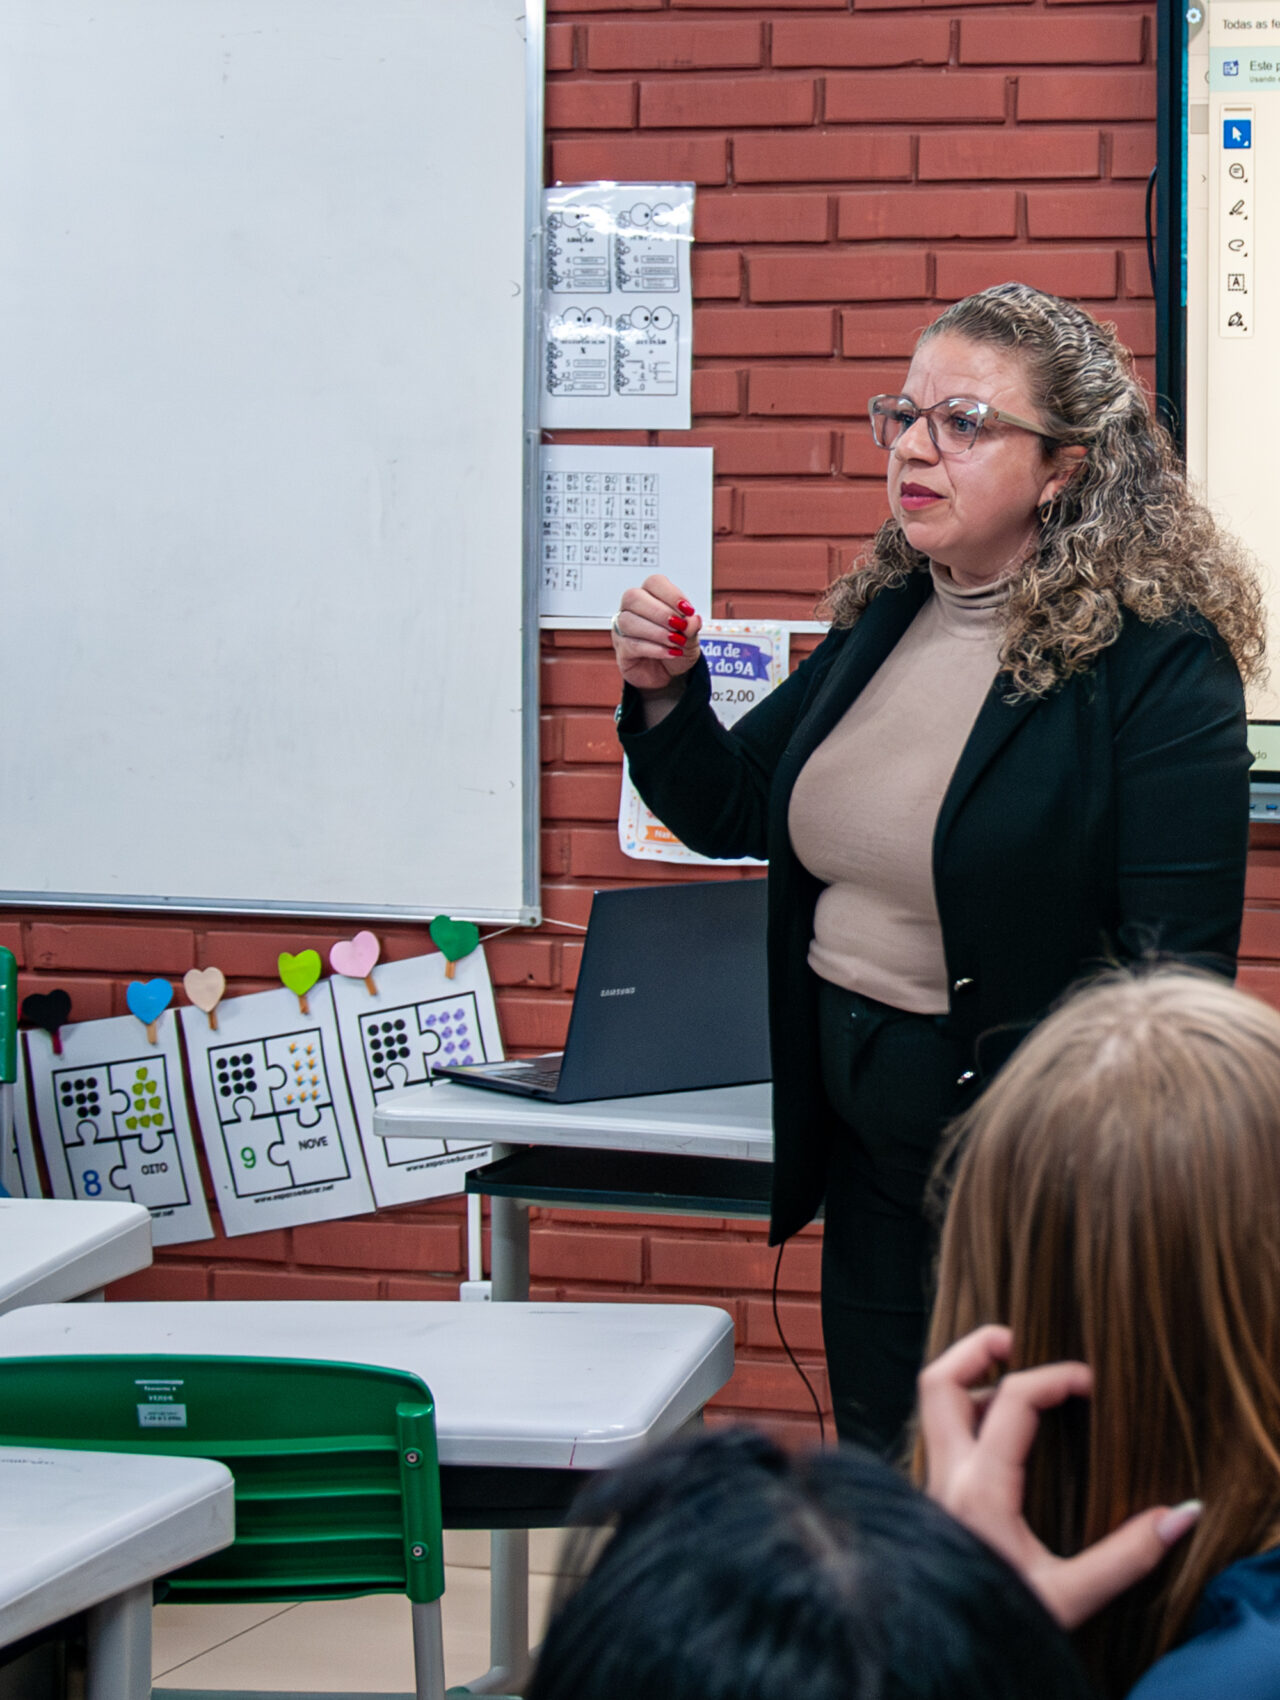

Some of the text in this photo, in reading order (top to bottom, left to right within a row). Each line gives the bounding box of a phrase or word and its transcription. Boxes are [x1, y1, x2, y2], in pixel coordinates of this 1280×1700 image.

[1223, 19, 1252, 29] Todas
[1255, 21, 1268, 29] as
[1250, 60, 1272, 71] Este
[723, 643, 741, 658] de
[715, 659, 734, 674] do
[734, 660, 755, 677] 9A
[726, 689, 755, 704] 2,00
[298, 1136, 329, 1151] NOVE
[240, 1146, 257, 1169] 9
[141, 1162, 169, 1176] OITO
[82, 1169, 102, 1197] 8
